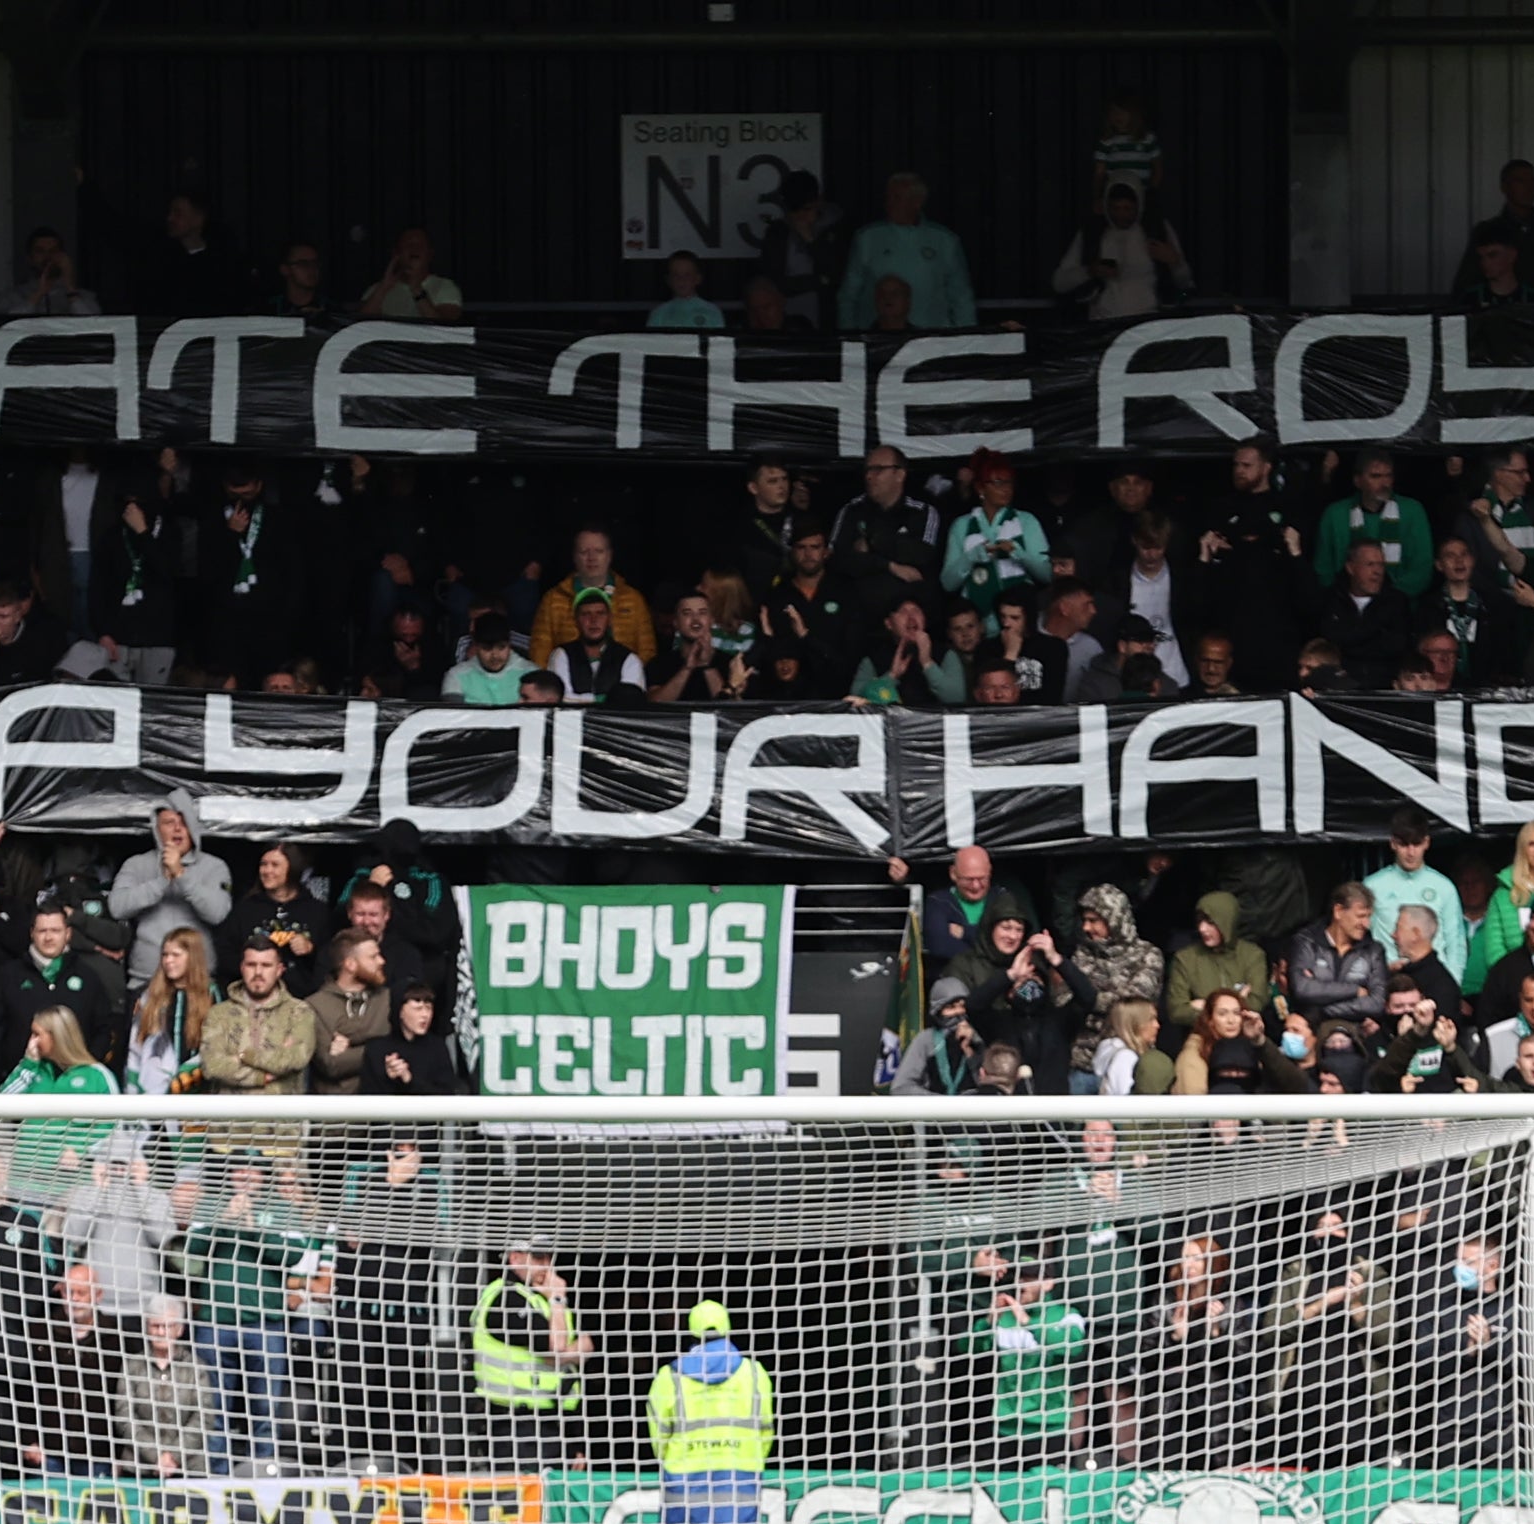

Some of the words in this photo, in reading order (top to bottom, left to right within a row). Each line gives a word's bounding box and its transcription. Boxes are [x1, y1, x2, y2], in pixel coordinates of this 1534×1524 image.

[634, 120, 730, 147] Seating
[739, 120, 808, 143] Block
[547, 329, 1035, 459] THE
[197, 695, 893, 856] YOUR
[486, 900, 767, 991] BHOYS
[479, 1014, 767, 1096] CELTIC
